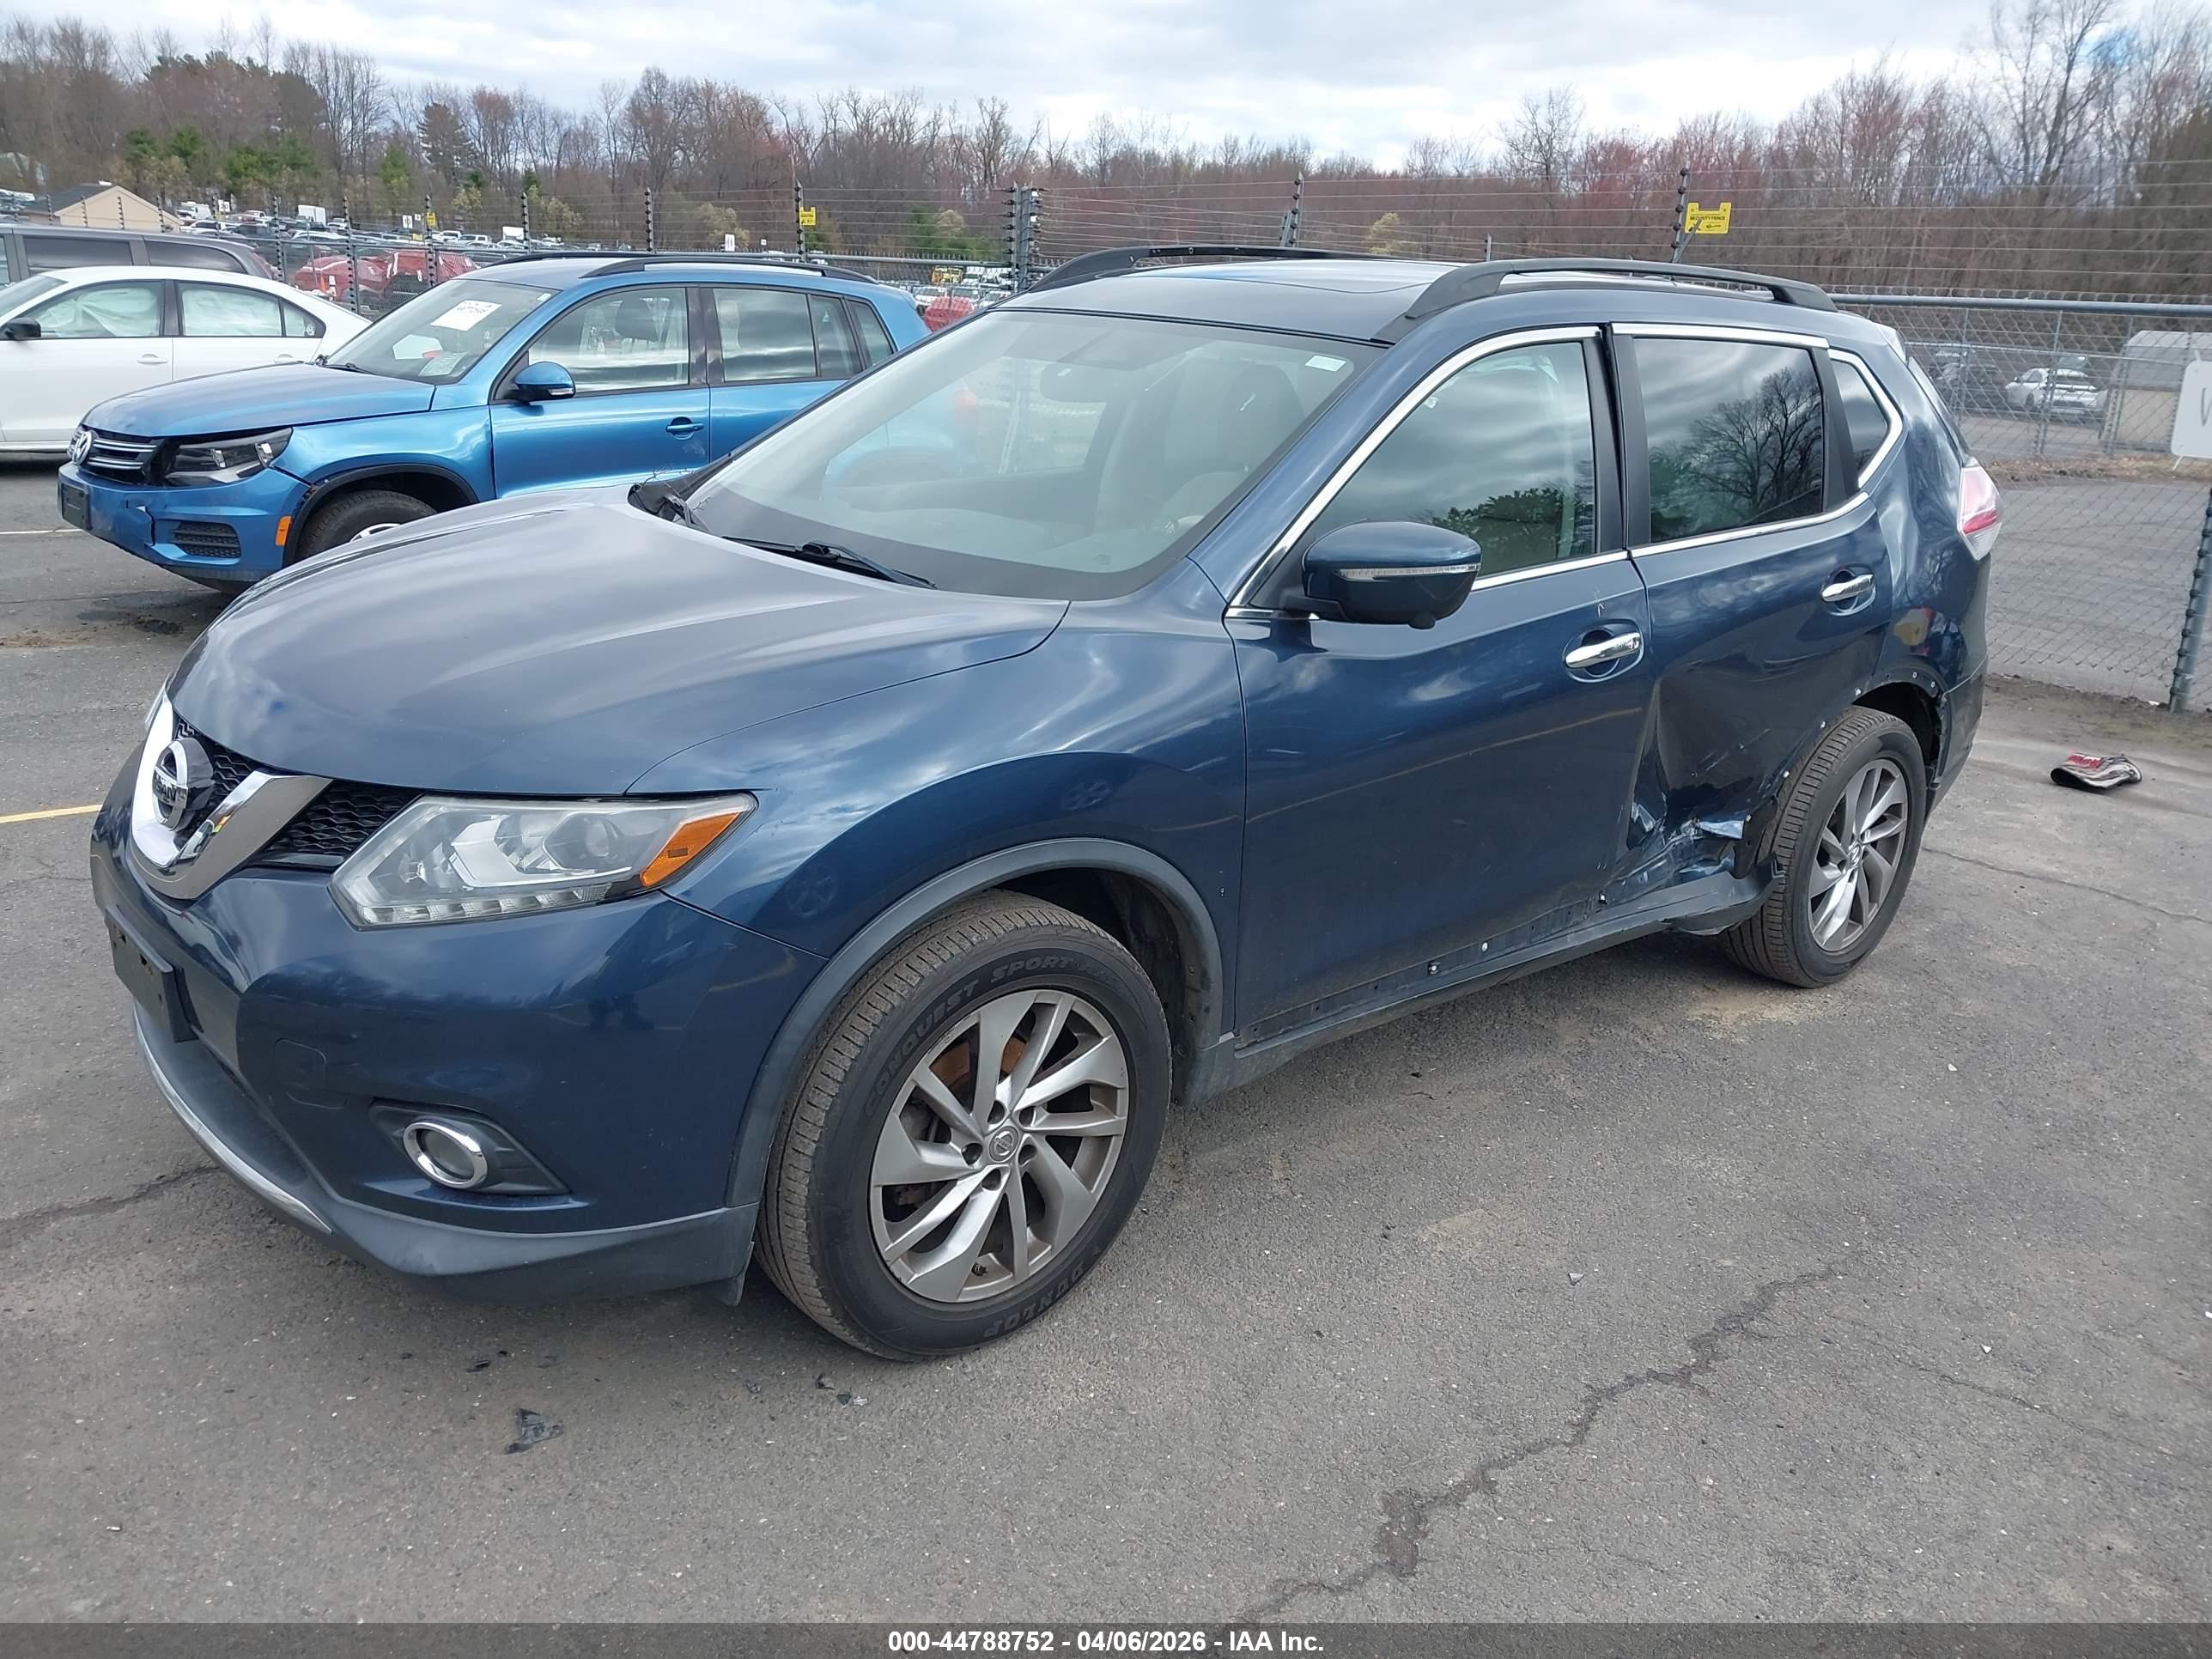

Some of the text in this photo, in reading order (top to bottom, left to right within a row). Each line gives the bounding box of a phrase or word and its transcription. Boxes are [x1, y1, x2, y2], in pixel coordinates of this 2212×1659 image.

[864, 979, 980, 1116] CONQUEST
[990, 954, 1074, 983] SPORT
[982, 1261, 1085, 1339] DUNLOP
